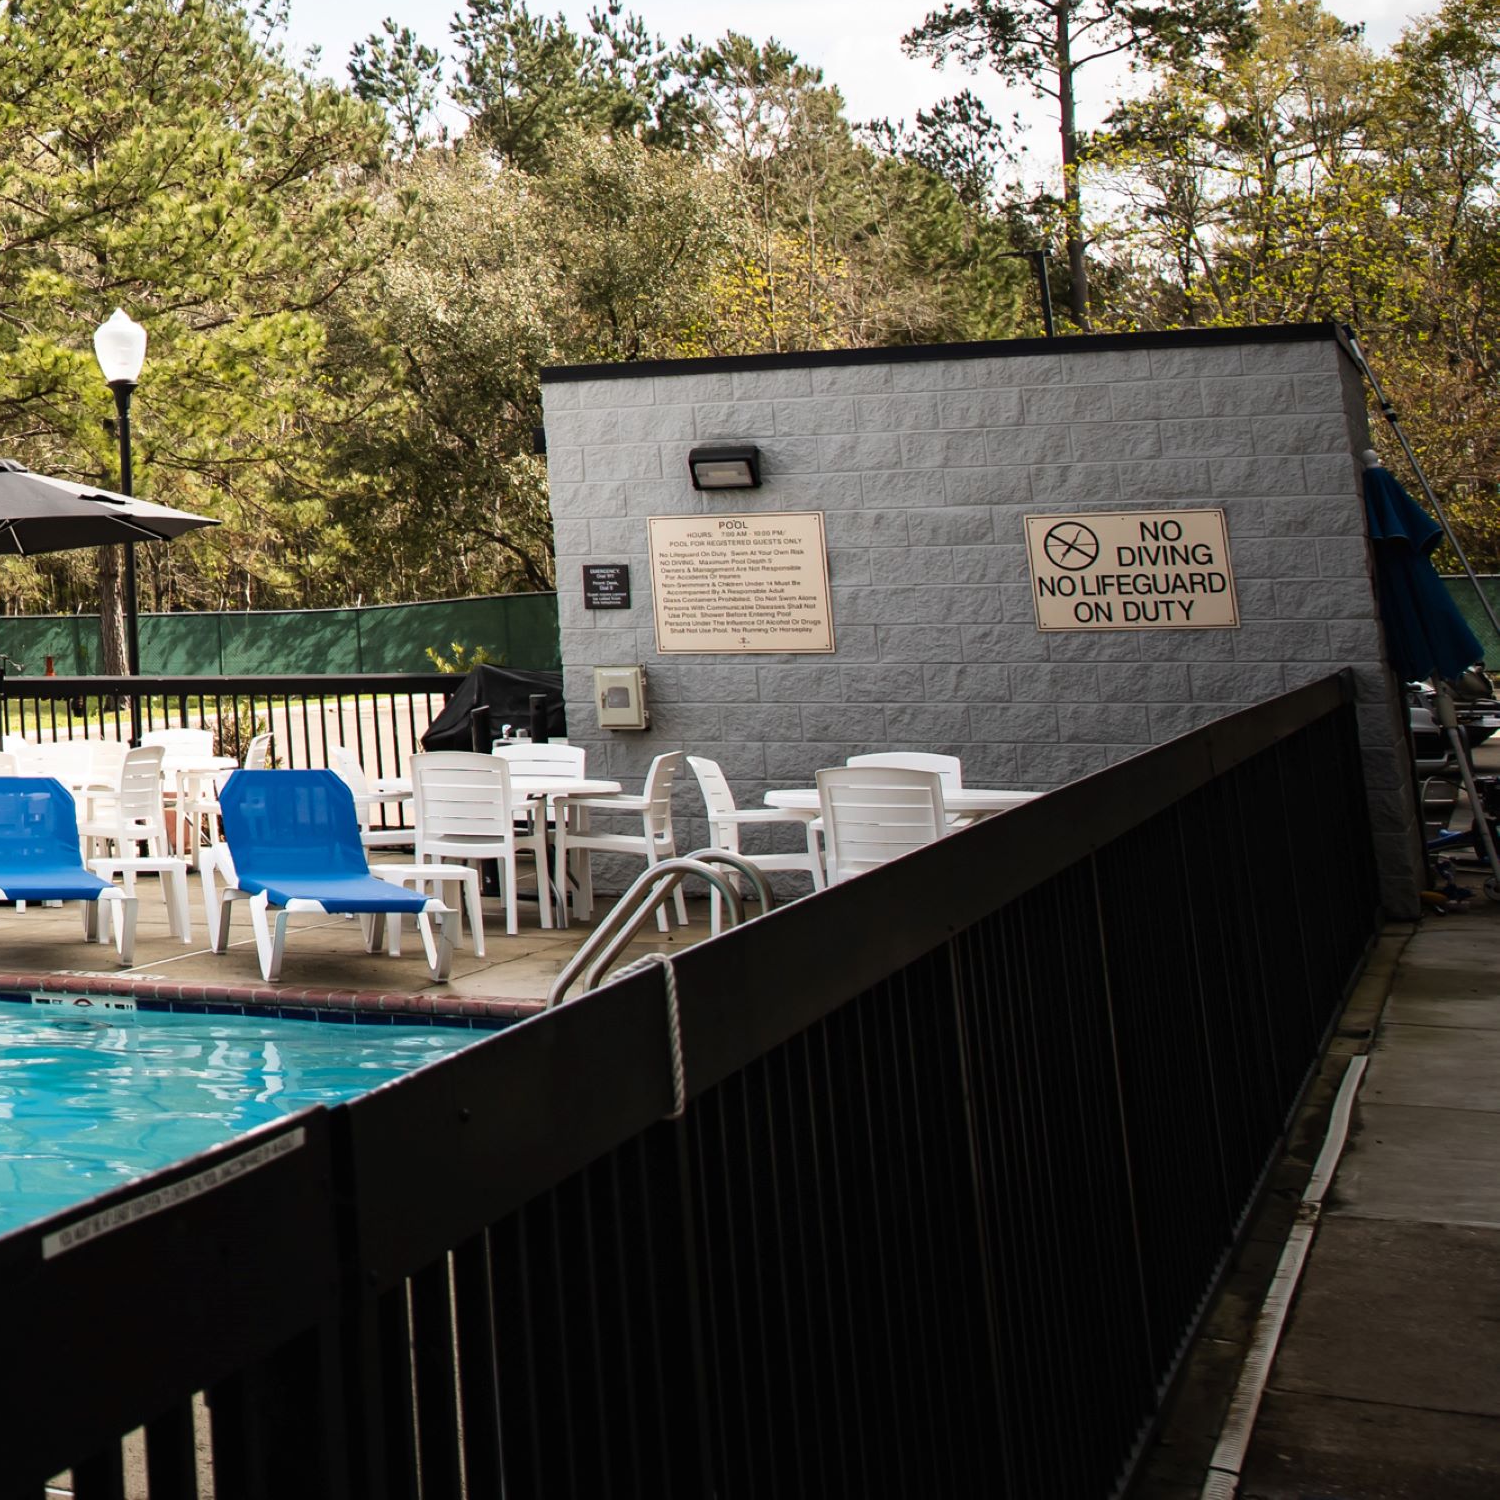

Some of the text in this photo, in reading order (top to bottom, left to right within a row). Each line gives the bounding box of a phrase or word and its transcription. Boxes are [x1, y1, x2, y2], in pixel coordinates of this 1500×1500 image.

[1139, 520, 1183, 542] NO
[1117, 544, 1213, 566] DIVING
[1038, 572, 1226, 596] NO LIFEGUARD
[1074, 600, 1194, 623] ON DUTY
